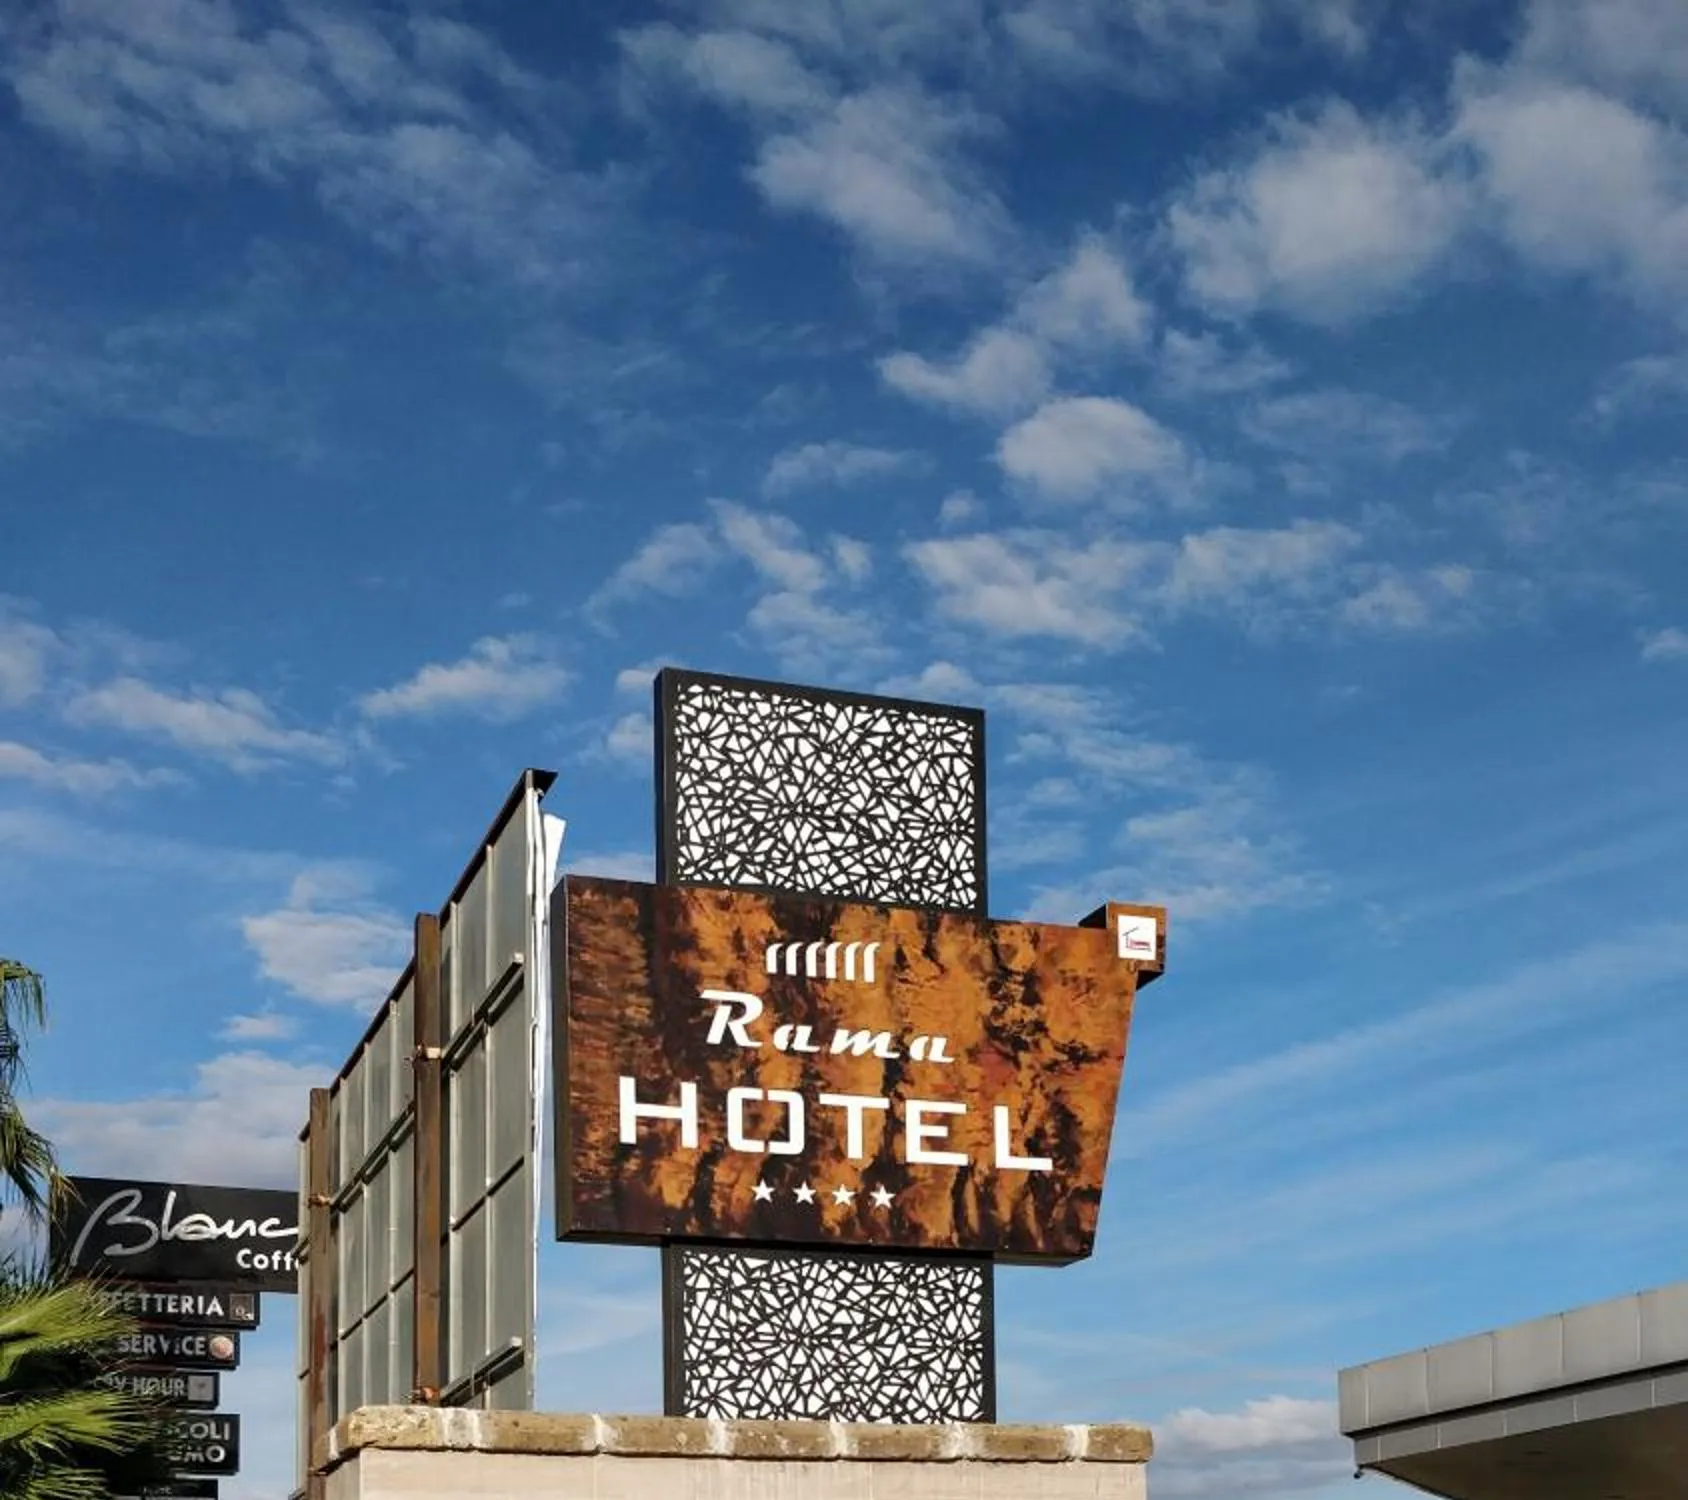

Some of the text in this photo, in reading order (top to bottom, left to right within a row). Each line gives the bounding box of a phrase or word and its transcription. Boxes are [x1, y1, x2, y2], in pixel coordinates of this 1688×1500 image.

[700, 989, 955, 1063] Rama
[618, 1075, 1054, 1172] HOTEL
[117, 1333, 207, 1356] SERVICE
